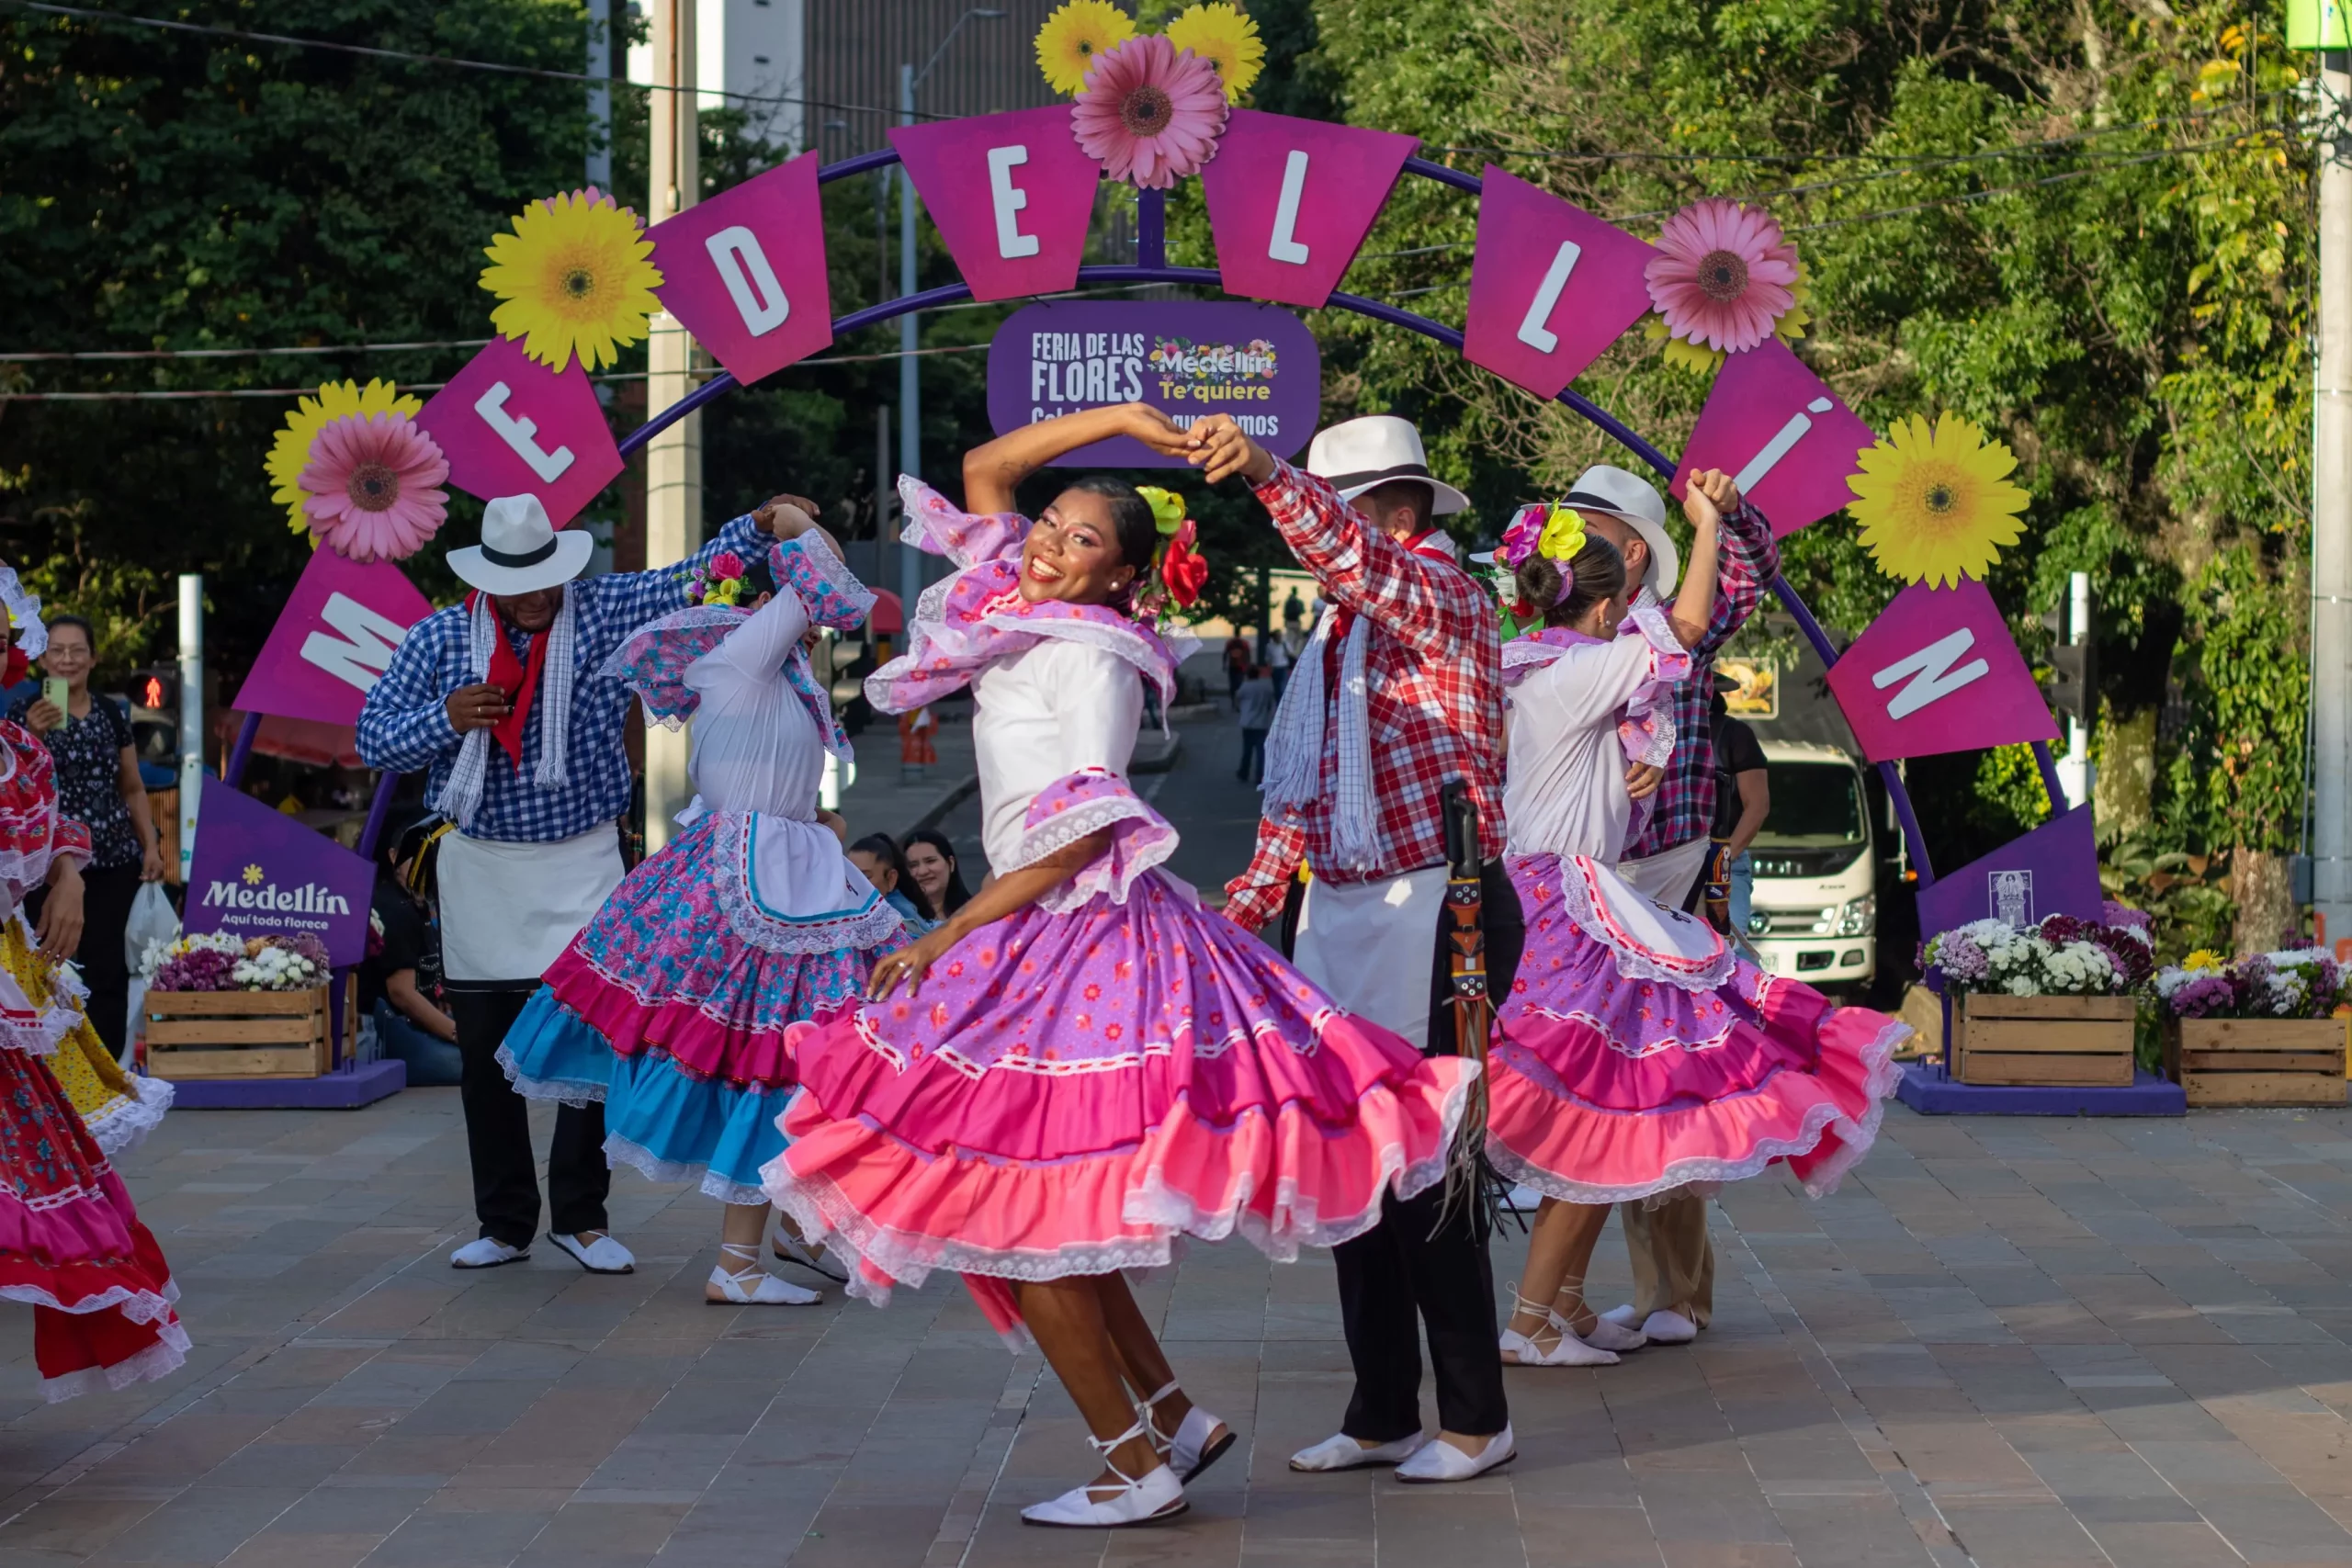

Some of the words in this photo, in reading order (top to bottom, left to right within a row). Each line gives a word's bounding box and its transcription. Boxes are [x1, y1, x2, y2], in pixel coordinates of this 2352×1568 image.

[1032, 333, 1081, 361] FERIA
[1085, 333, 1108, 358] DE
[1112, 333, 1145, 357] LAS
[1031, 355, 1144, 402] FLORES
[1159, 380, 1187, 400] Te
[1193, 379, 1271, 403] quiere
[201, 880, 351, 916] Medellín
[220, 912, 252, 926] Aquí
[253, 914, 282, 927] todo
[284, 915, 329, 931] florece
